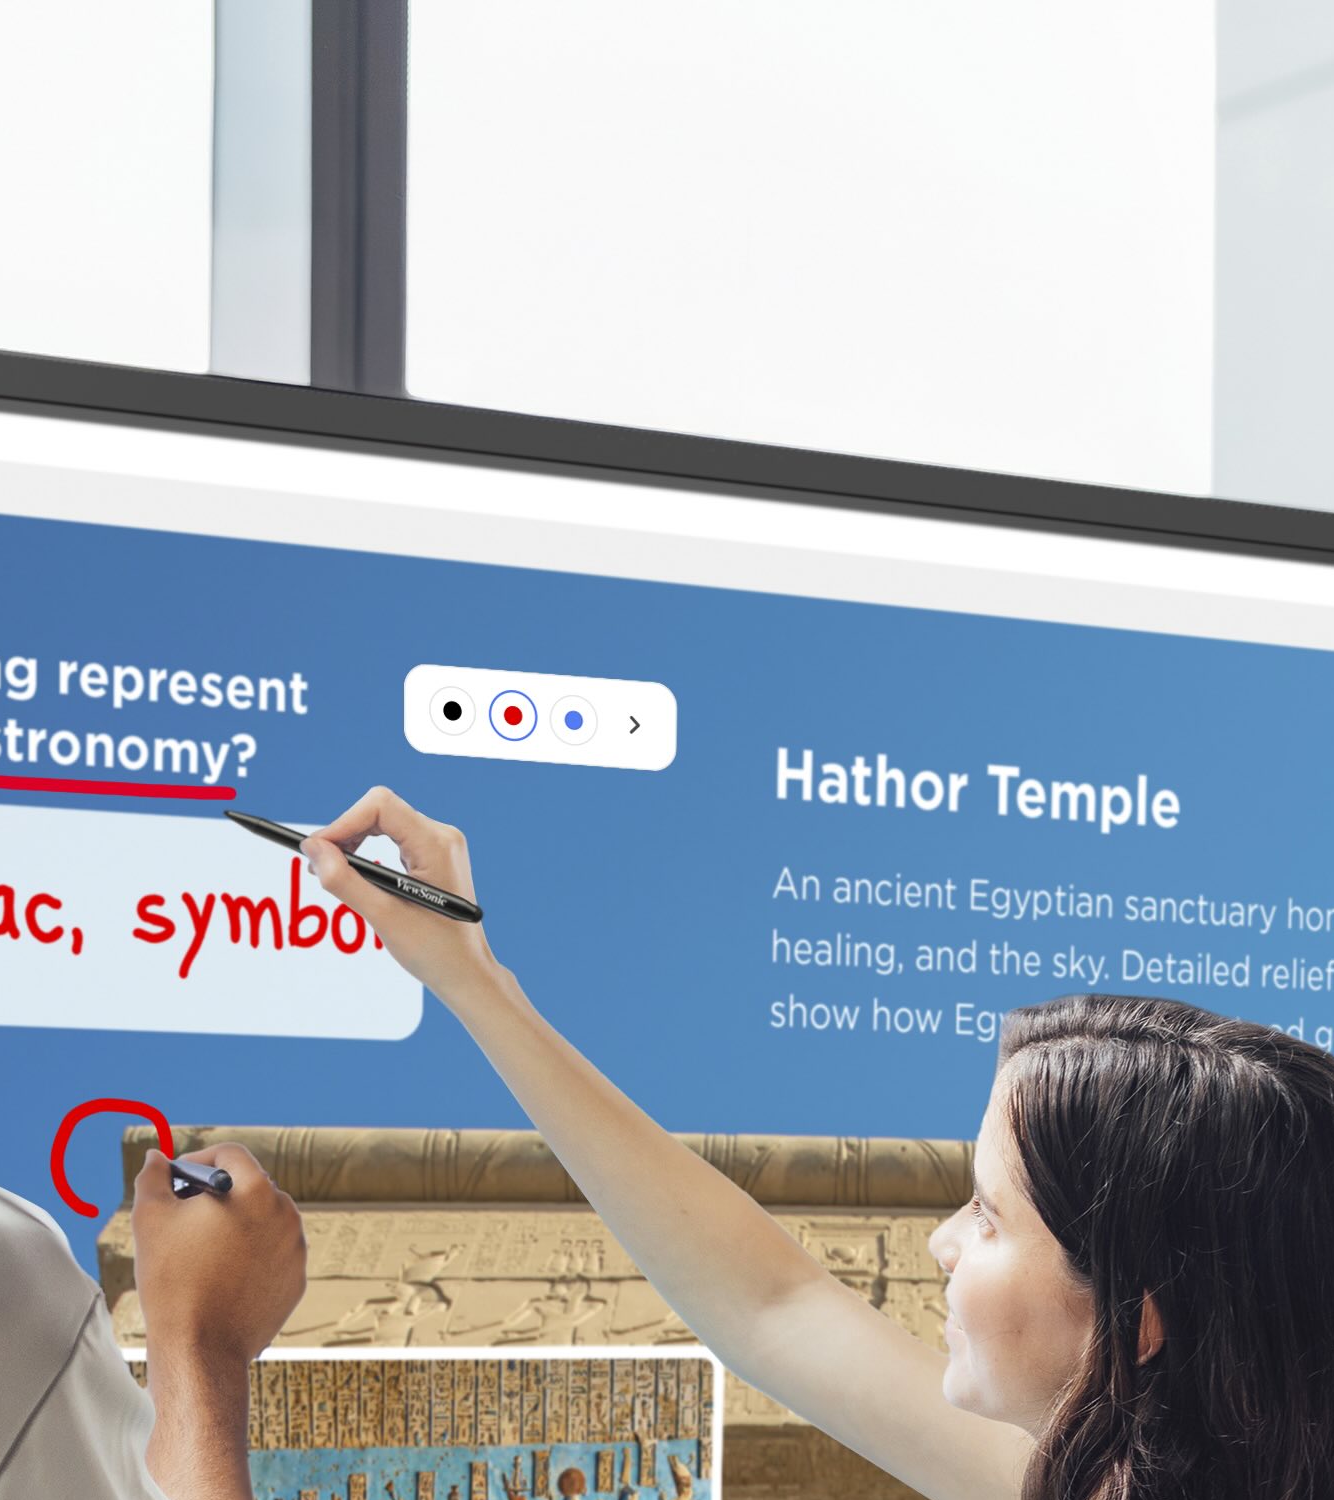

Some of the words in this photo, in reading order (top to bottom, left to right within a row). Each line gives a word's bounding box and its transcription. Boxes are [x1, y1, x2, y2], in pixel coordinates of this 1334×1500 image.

[59, 661, 308, 715] represent
[777, 747, 968, 812] Hathor
[987, 764, 1180, 834] Temple
[395, 878, 448, 907] ViewSonic
[771, 865, 821, 902] An
[831, 872, 958, 911] ancient
[969, 877, 1114, 921] Egyptian
[1124, 894, 1278, 935] sanctuary
[771, 927, 904, 976] healing,
[914, 941, 978, 975] and
[988, 940, 1042, 978] the
[1052, 944, 1110, 987] sky.
[1121, 948, 1251, 989] Detailed
[769, 992, 861, 1031] show
[872, 996, 943, 1035] how
